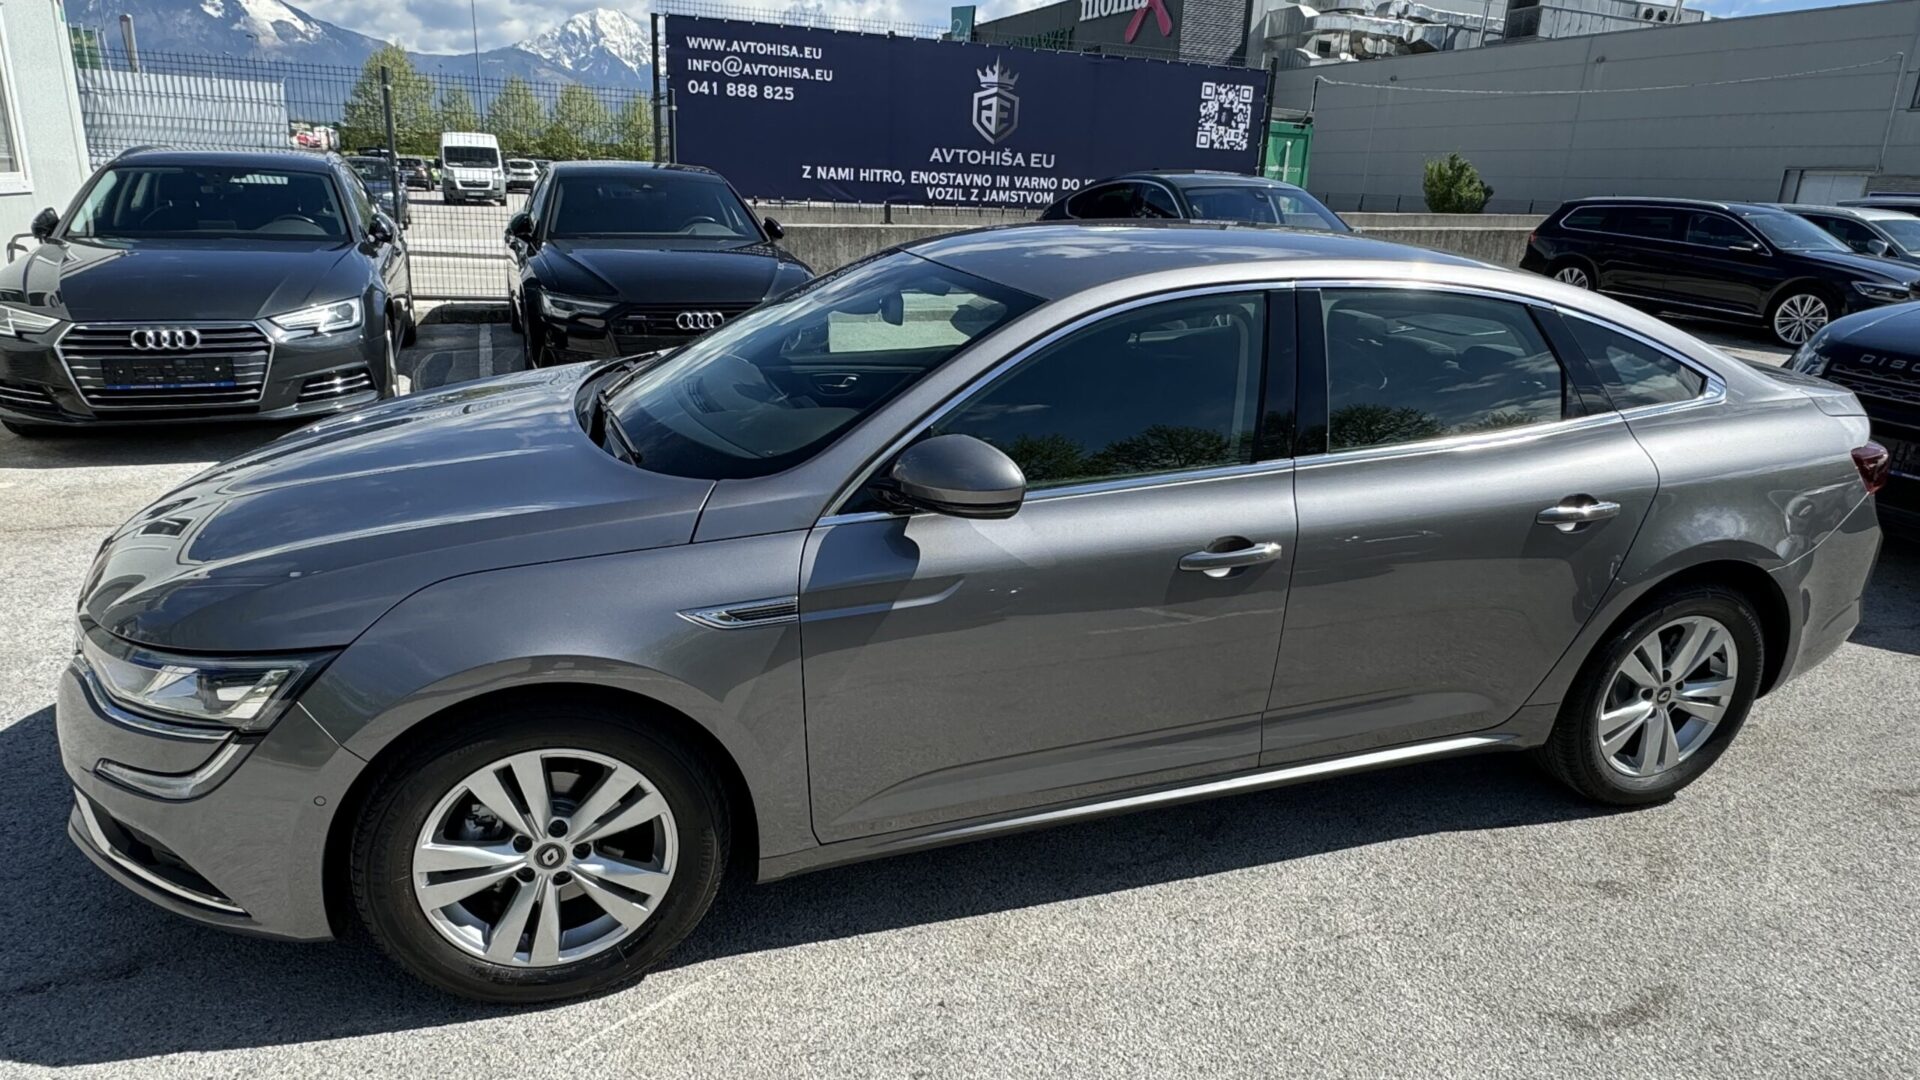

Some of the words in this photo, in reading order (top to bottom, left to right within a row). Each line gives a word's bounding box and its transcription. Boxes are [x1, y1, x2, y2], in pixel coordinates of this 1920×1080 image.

[686, 36, 822, 59] WWW.AVTOHISA.EU
[687, 55, 833, 82] INFO@AVTOHISA.EU
[687, 80, 718, 95] 041
[726, 83, 758, 98] 888
[763, 85, 794, 100] 825
[929, 148, 1025, 167] AVTOHIŠA
[1030, 153, 1055, 168] EU
[802, 165, 811, 179] Z
[817, 166, 854, 181] NAMI
[860, 168, 905, 186] HITRO,
[910, 171, 992, 187] ENOSTAVNO
[996, 175, 1009, 188] IN
[1014, 176, 1058, 190] VARNO
[1061, 178, 1080, 191] DO
[926, 187, 966, 201] VOZIL
[970, 189, 979, 201] Z
[982, 189, 1054, 204] JAMSTVOM
